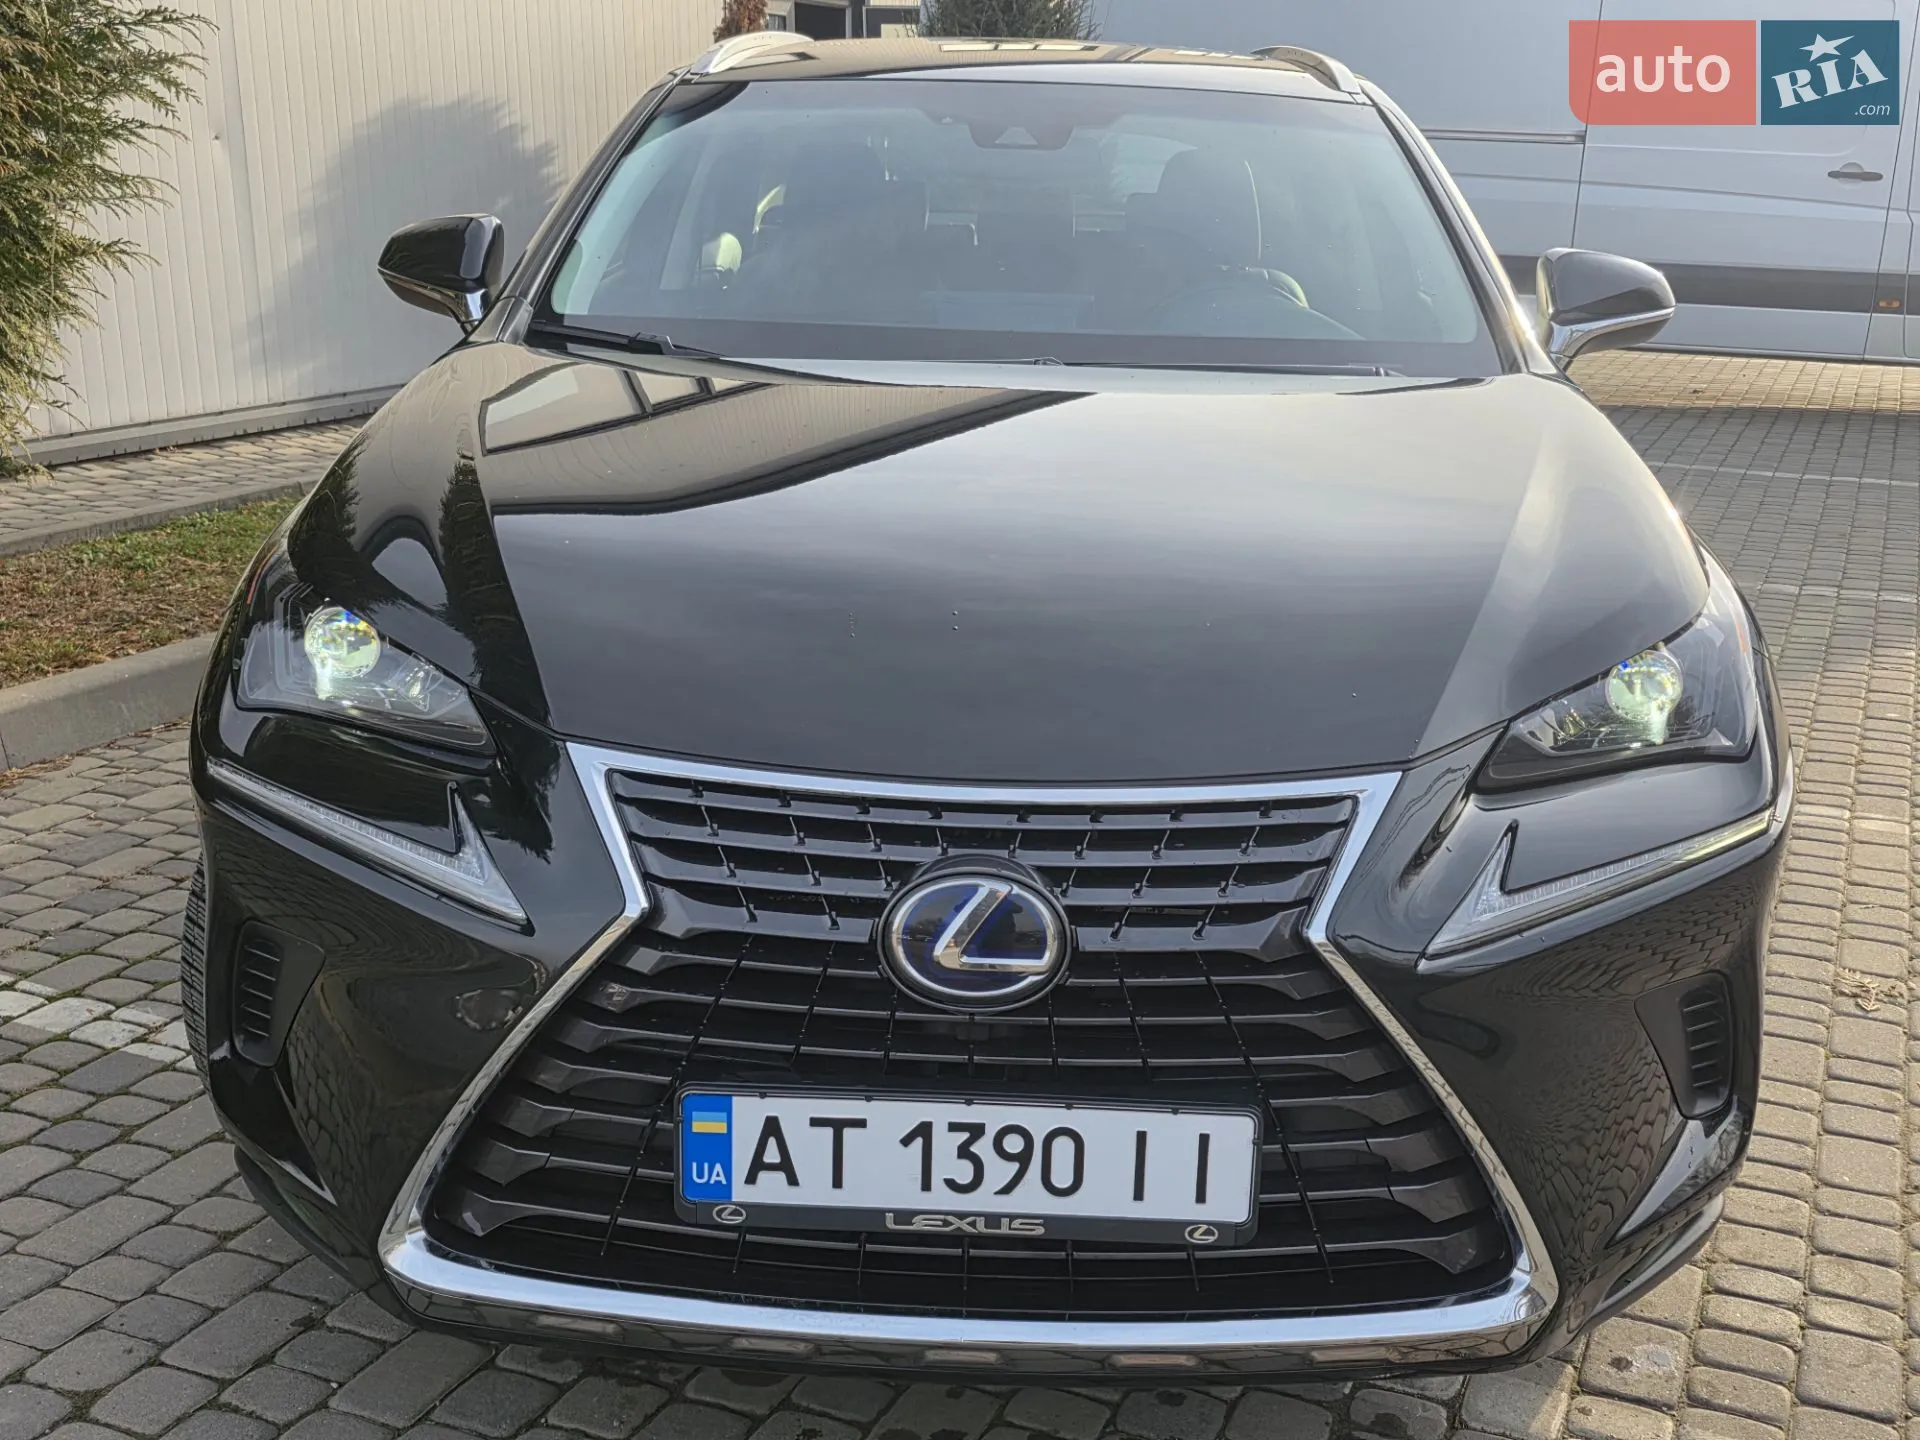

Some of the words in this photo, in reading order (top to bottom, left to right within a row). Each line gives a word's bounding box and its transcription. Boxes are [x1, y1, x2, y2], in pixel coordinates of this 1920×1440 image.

[744, 1115, 868, 1190] AT
[899, 1120, 1086, 1198] 1390
[1132, 1130, 1211, 1205] II
[691, 1162, 727, 1185] UA
[885, 1212, 1046, 1236] LEXUS
